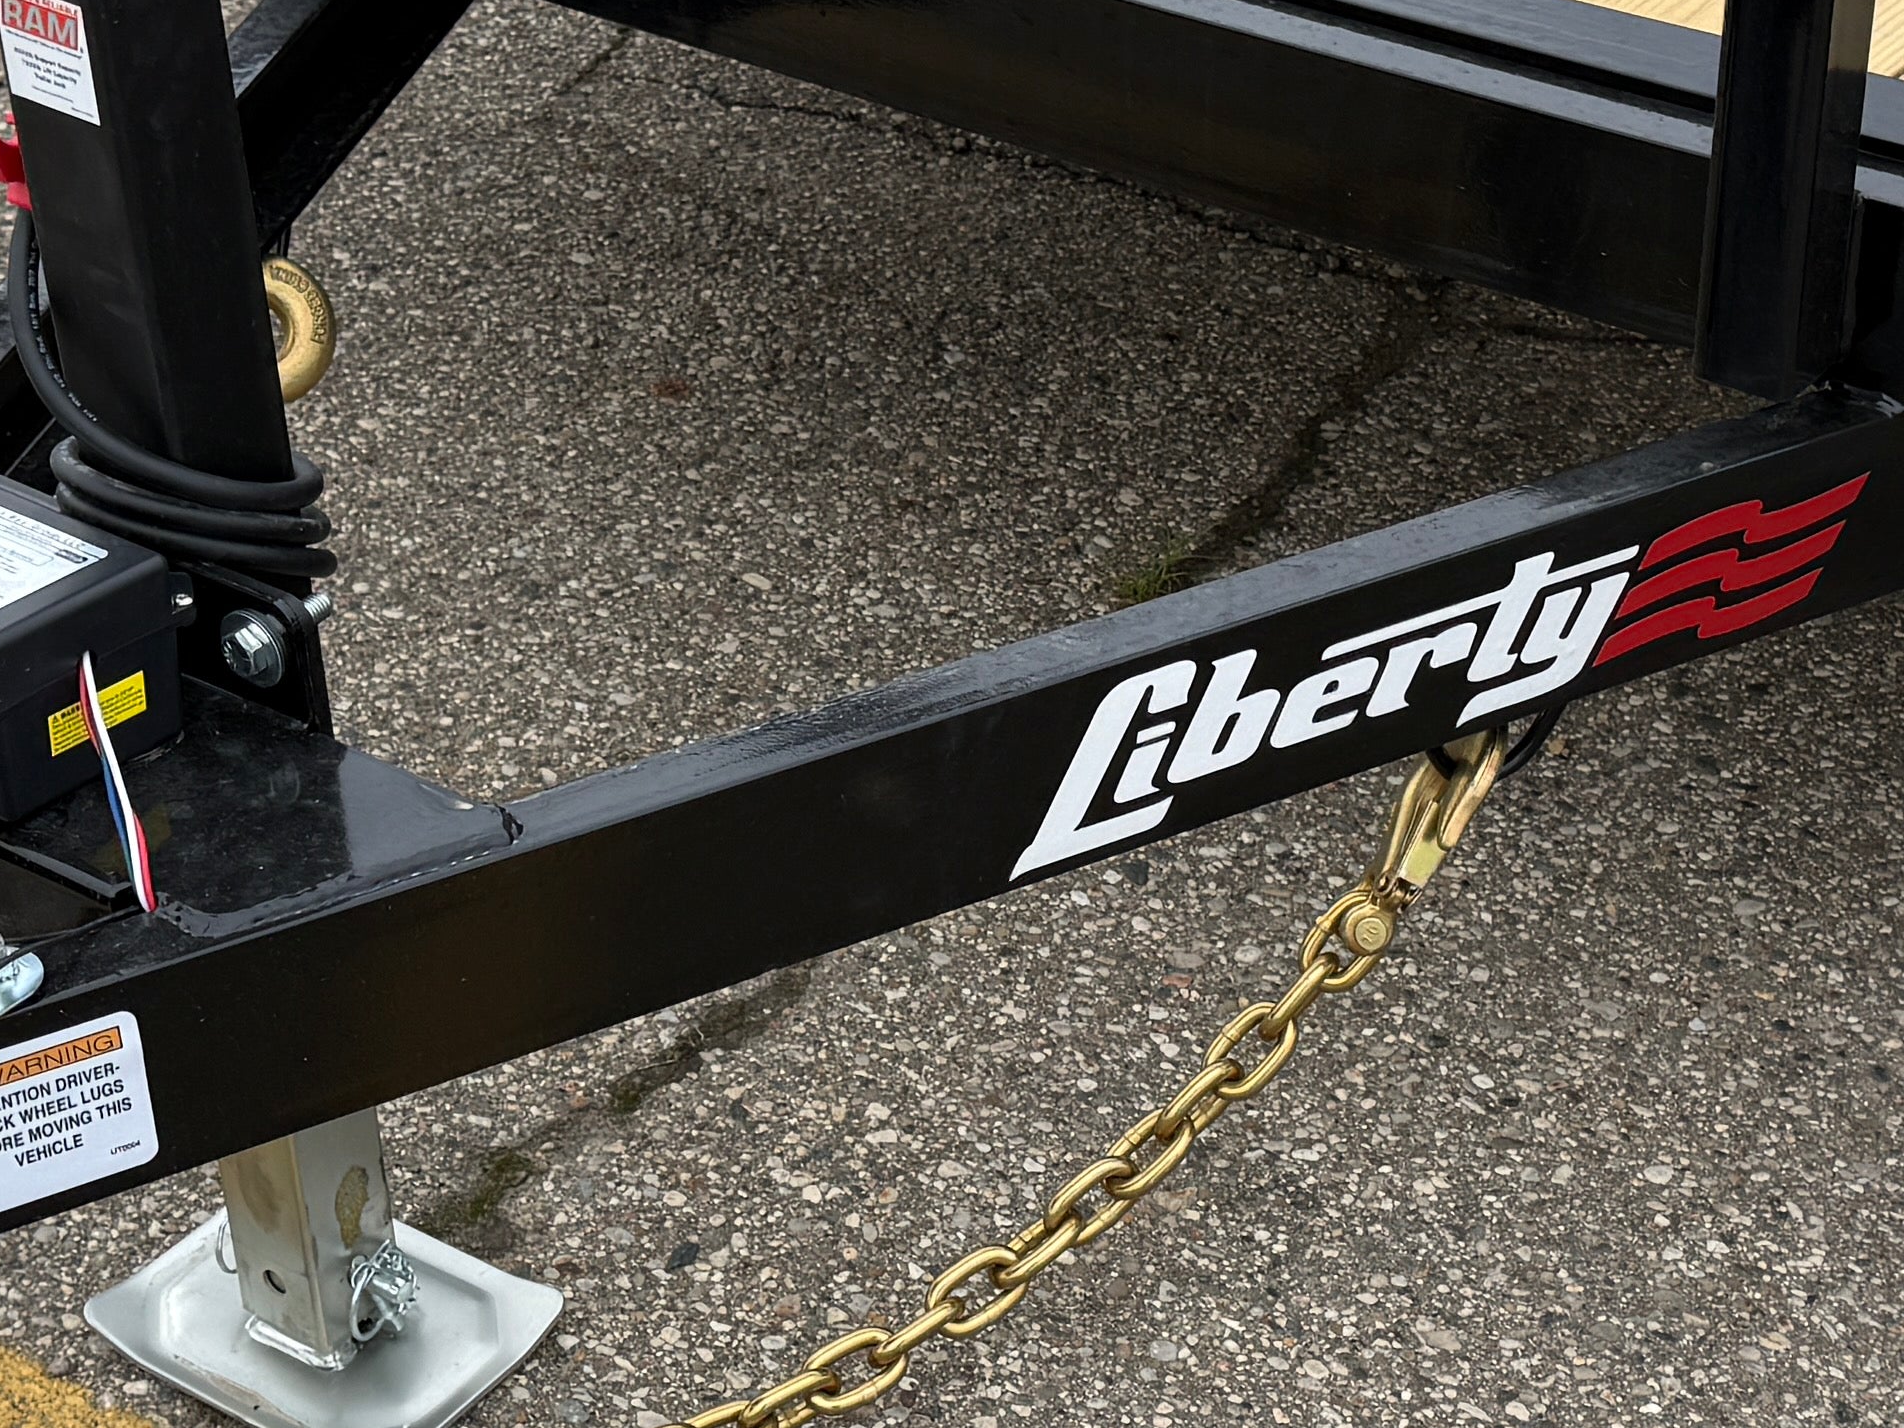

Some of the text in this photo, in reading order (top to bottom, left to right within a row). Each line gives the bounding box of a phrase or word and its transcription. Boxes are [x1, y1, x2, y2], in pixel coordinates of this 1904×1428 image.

[1009, 543, 1642, 882] Liberty
[55, 1062, 119, 1092] DRIVER-
[18, 1095, 77, 1123] WHEEL
[80, 1079, 123, 1104] LUGS
[27, 1110, 92, 1142] MOVING
[95, 1097, 131, 1119] THIS
[14, 1133, 83, 1166] VEHICLE
